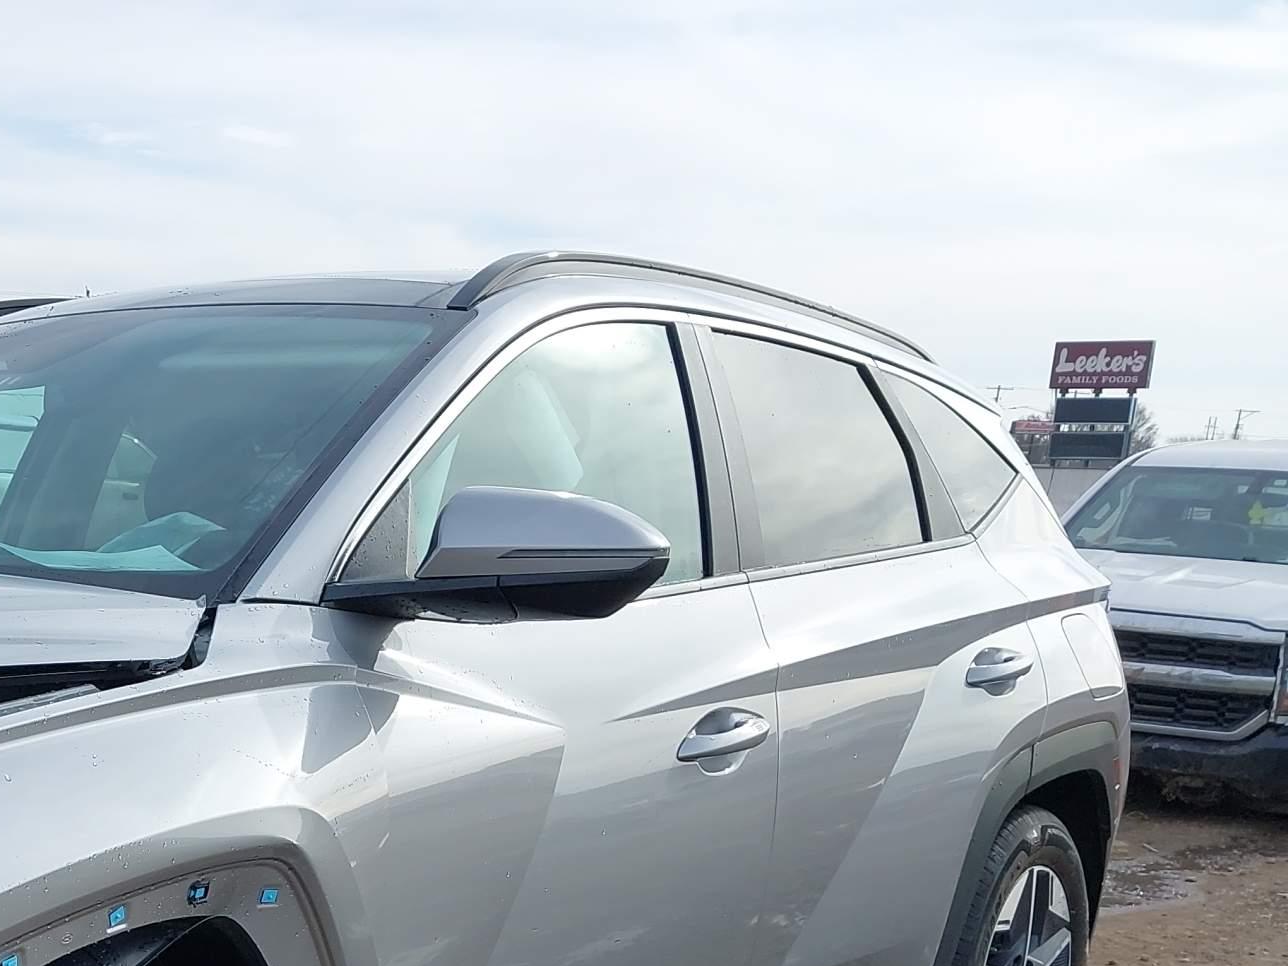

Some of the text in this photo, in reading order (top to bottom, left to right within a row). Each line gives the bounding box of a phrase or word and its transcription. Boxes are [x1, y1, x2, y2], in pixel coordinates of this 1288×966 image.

[1055, 347, 1147, 373] Leeker's
[1057, 375, 1139, 384] FAMILY FOODS
